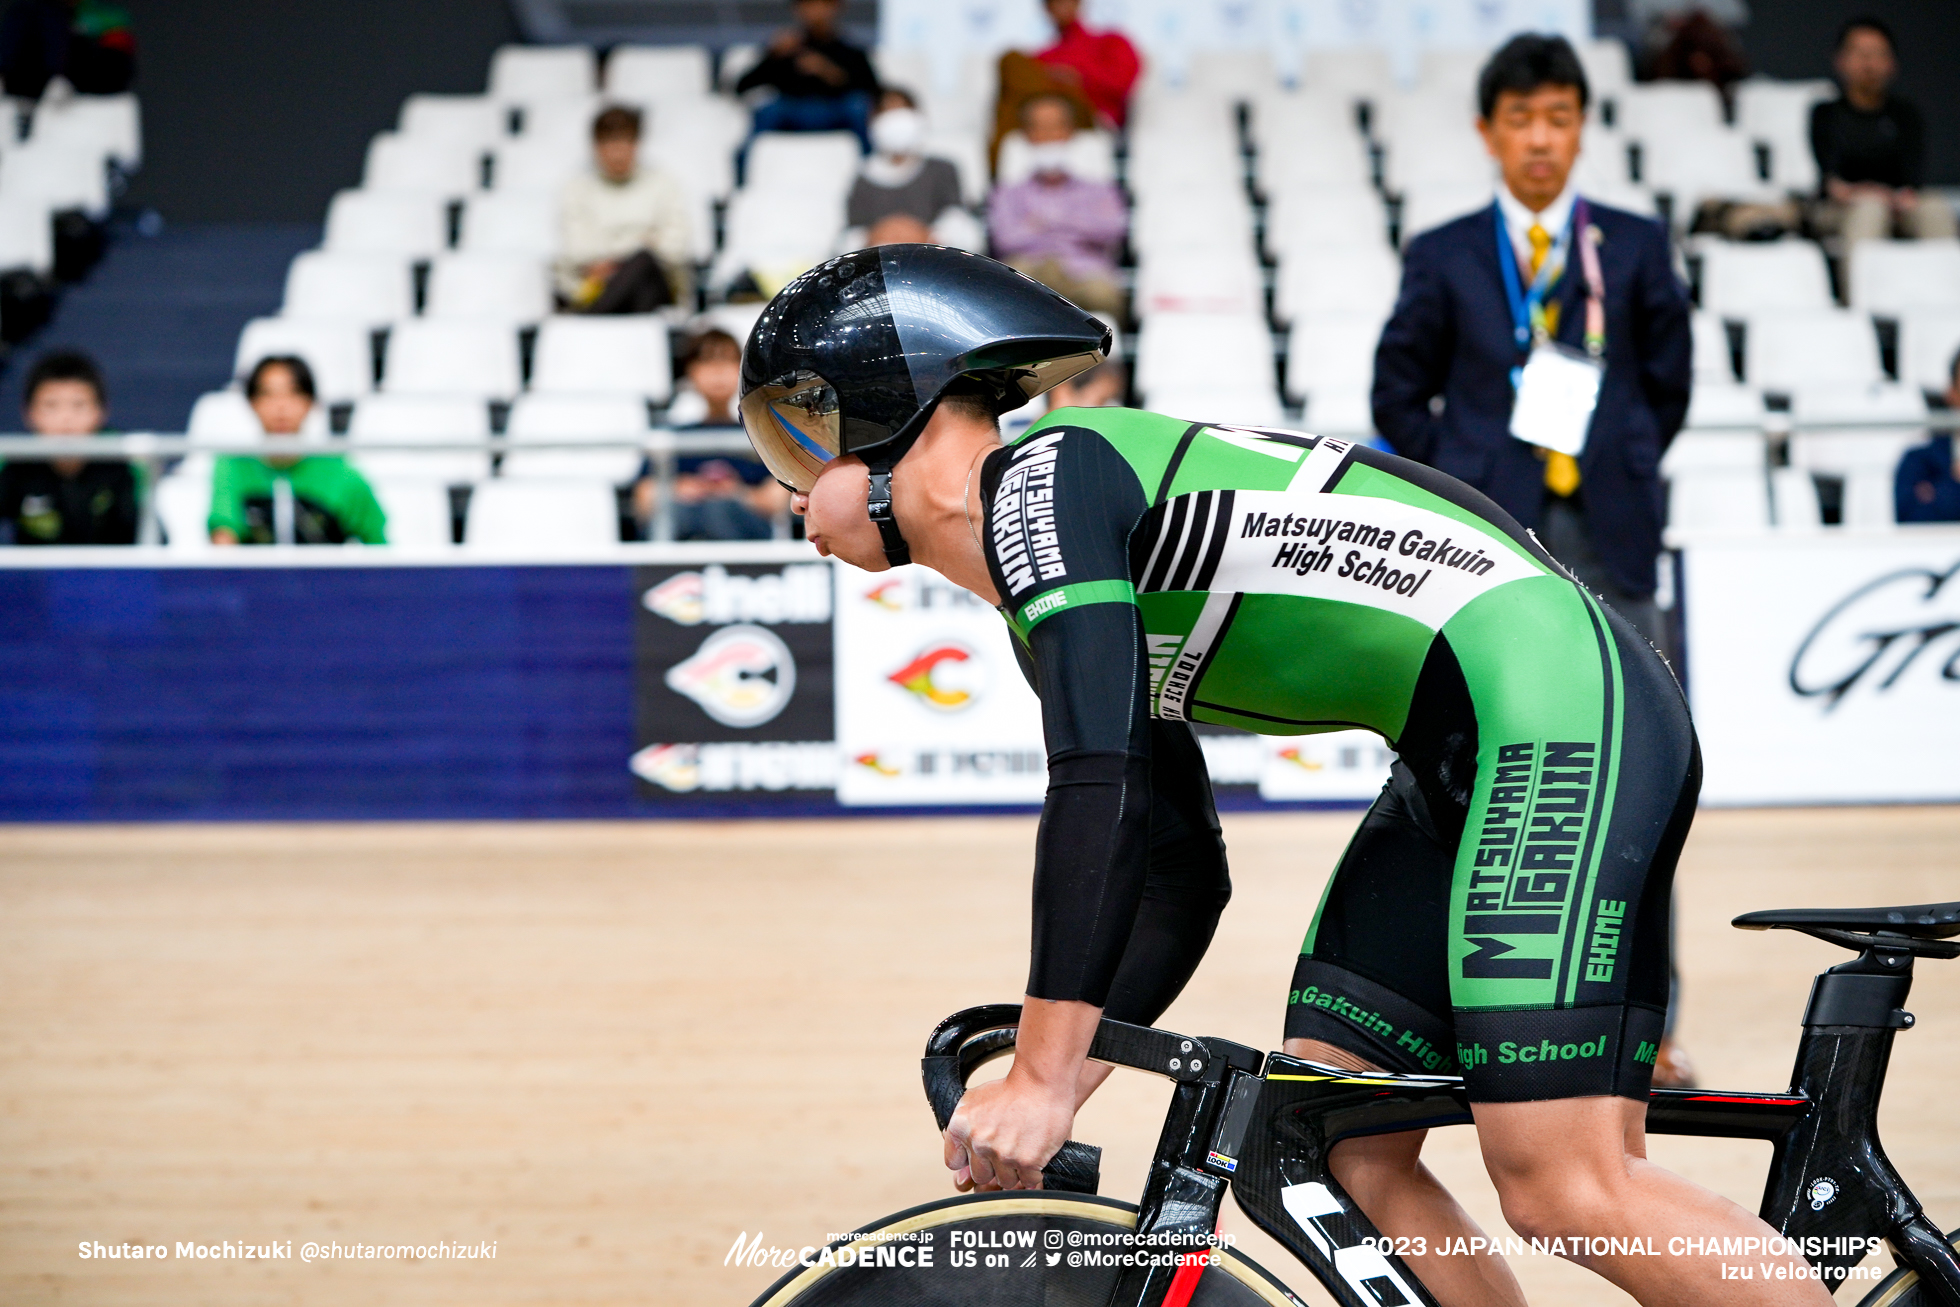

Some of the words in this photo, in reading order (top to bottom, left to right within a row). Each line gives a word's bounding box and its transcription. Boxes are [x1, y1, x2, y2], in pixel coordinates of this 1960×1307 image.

[992, 468, 1037, 597] GAKUIN
[1240, 512, 1396, 551] Matsuyama
[1399, 530, 1495, 577] Gakuin
[1272, 543, 1334, 577] High
[1338, 550, 1431, 598] School
[1024, 590, 1068, 622] EHIME
[1164, 652, 1203, 703] SCHOOL
[1510, 742, 1596, 903] GAKUIN
[1461, 742, 1563, 980] MATSUYAMA
[1584, 898, 1627, 983] EHIME
[1301, 985, 1393, 1037] Gakuin
[1498, 1035, 1606, 1064] School
[1207, 1155, 1229, 1169] LOOK
